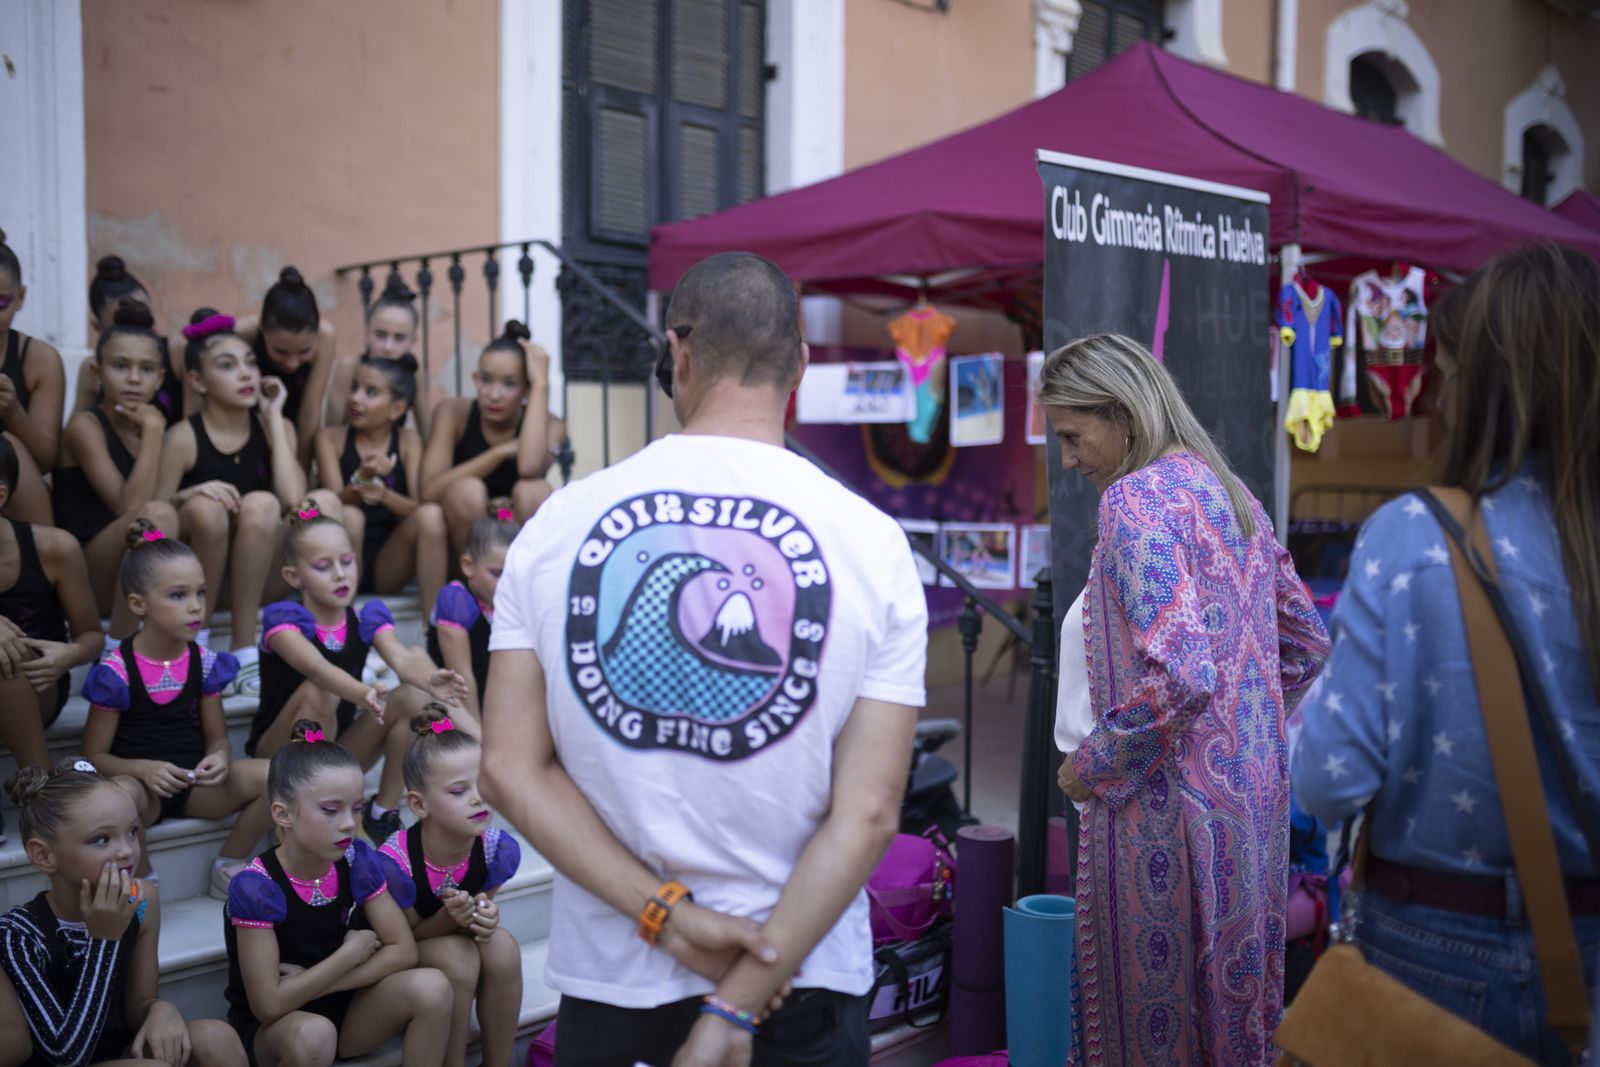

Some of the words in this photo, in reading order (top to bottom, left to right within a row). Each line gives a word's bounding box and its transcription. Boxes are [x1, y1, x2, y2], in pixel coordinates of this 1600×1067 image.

[1051, 185, 1087, 243] Club
[1091, 192, 1163, 251] Gimnasia
[1218, 213, 1265, 265] Huelva
[578, 493, 828, 589] QUIKSILVER
[570, 596, 597, 616] 19
[793, 618, 825, 642] 69
[570, 641, 644, 740] DOING
[656, 719, 733, 756] FINE
[745, 657, 818, 748] SINCE
